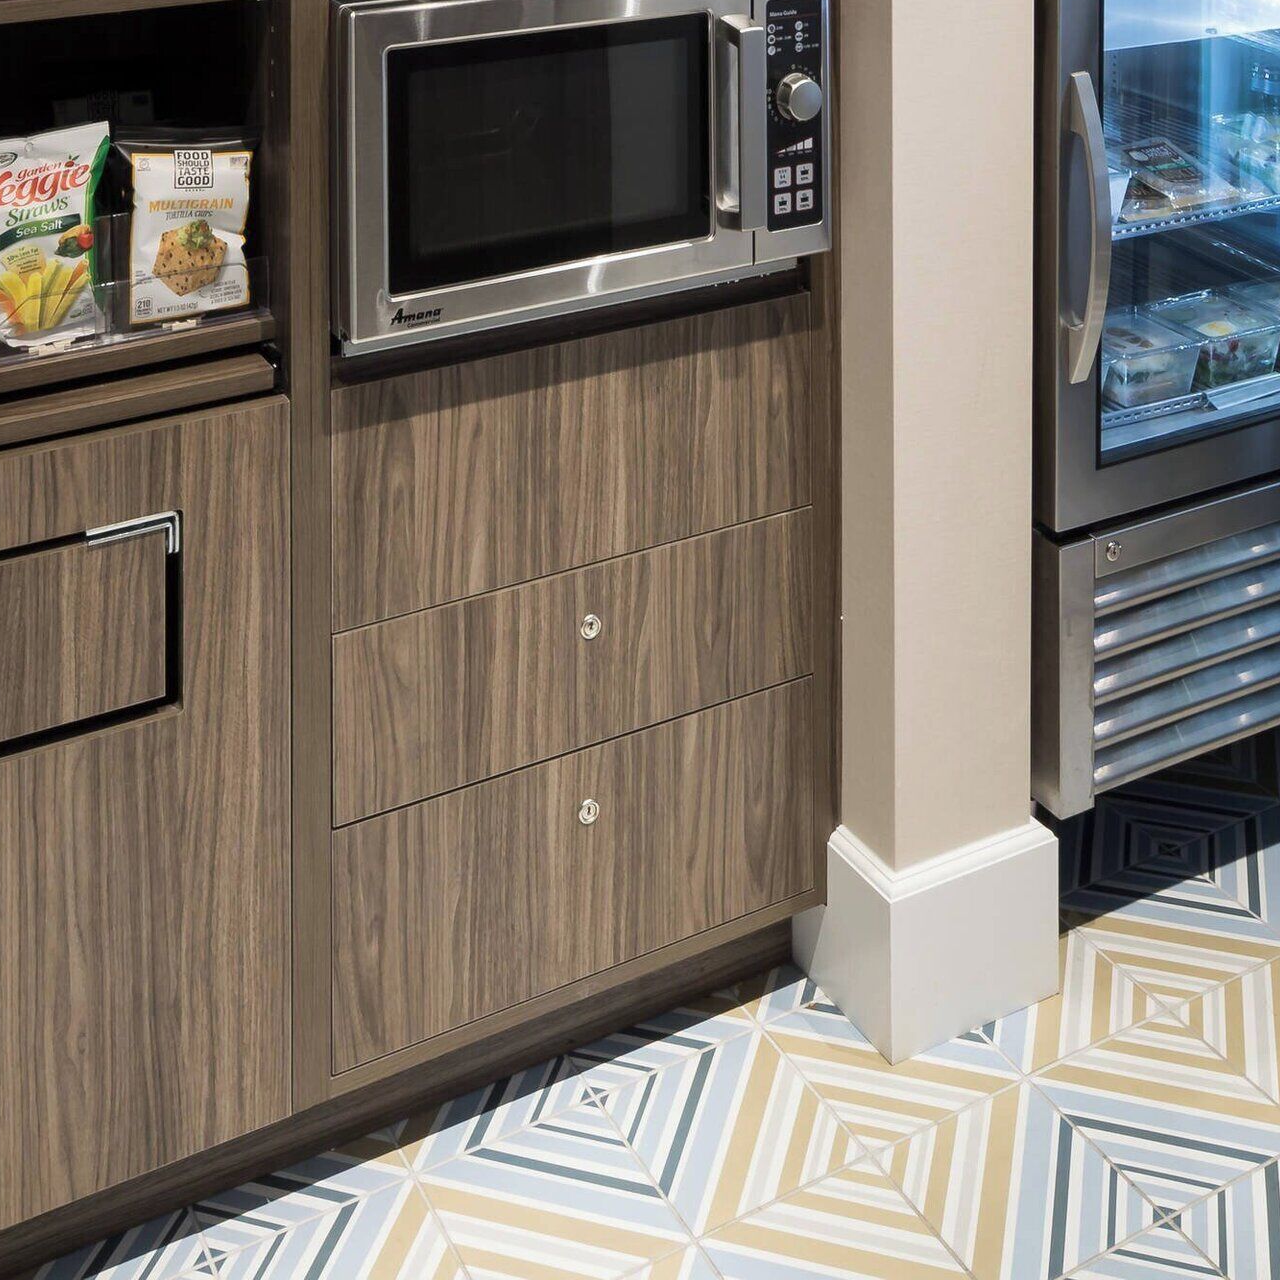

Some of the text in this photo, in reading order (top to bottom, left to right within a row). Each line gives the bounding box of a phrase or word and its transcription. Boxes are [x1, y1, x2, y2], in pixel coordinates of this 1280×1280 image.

[176, 151, 210, 160] FOOD
[16, 160, 62, 182] garden
[177, 159, 210, 168] SHOULD
[178, 167, 210, 176] TASTE
[177, 176, 210, 187] GOOD
[5, 196, 69, 227] Straws
[149, 198, 234, 213] MULTIGRAIN
[16, 219, 63, 238] Sea Salt
[391, 308, 442, 325] Amana
